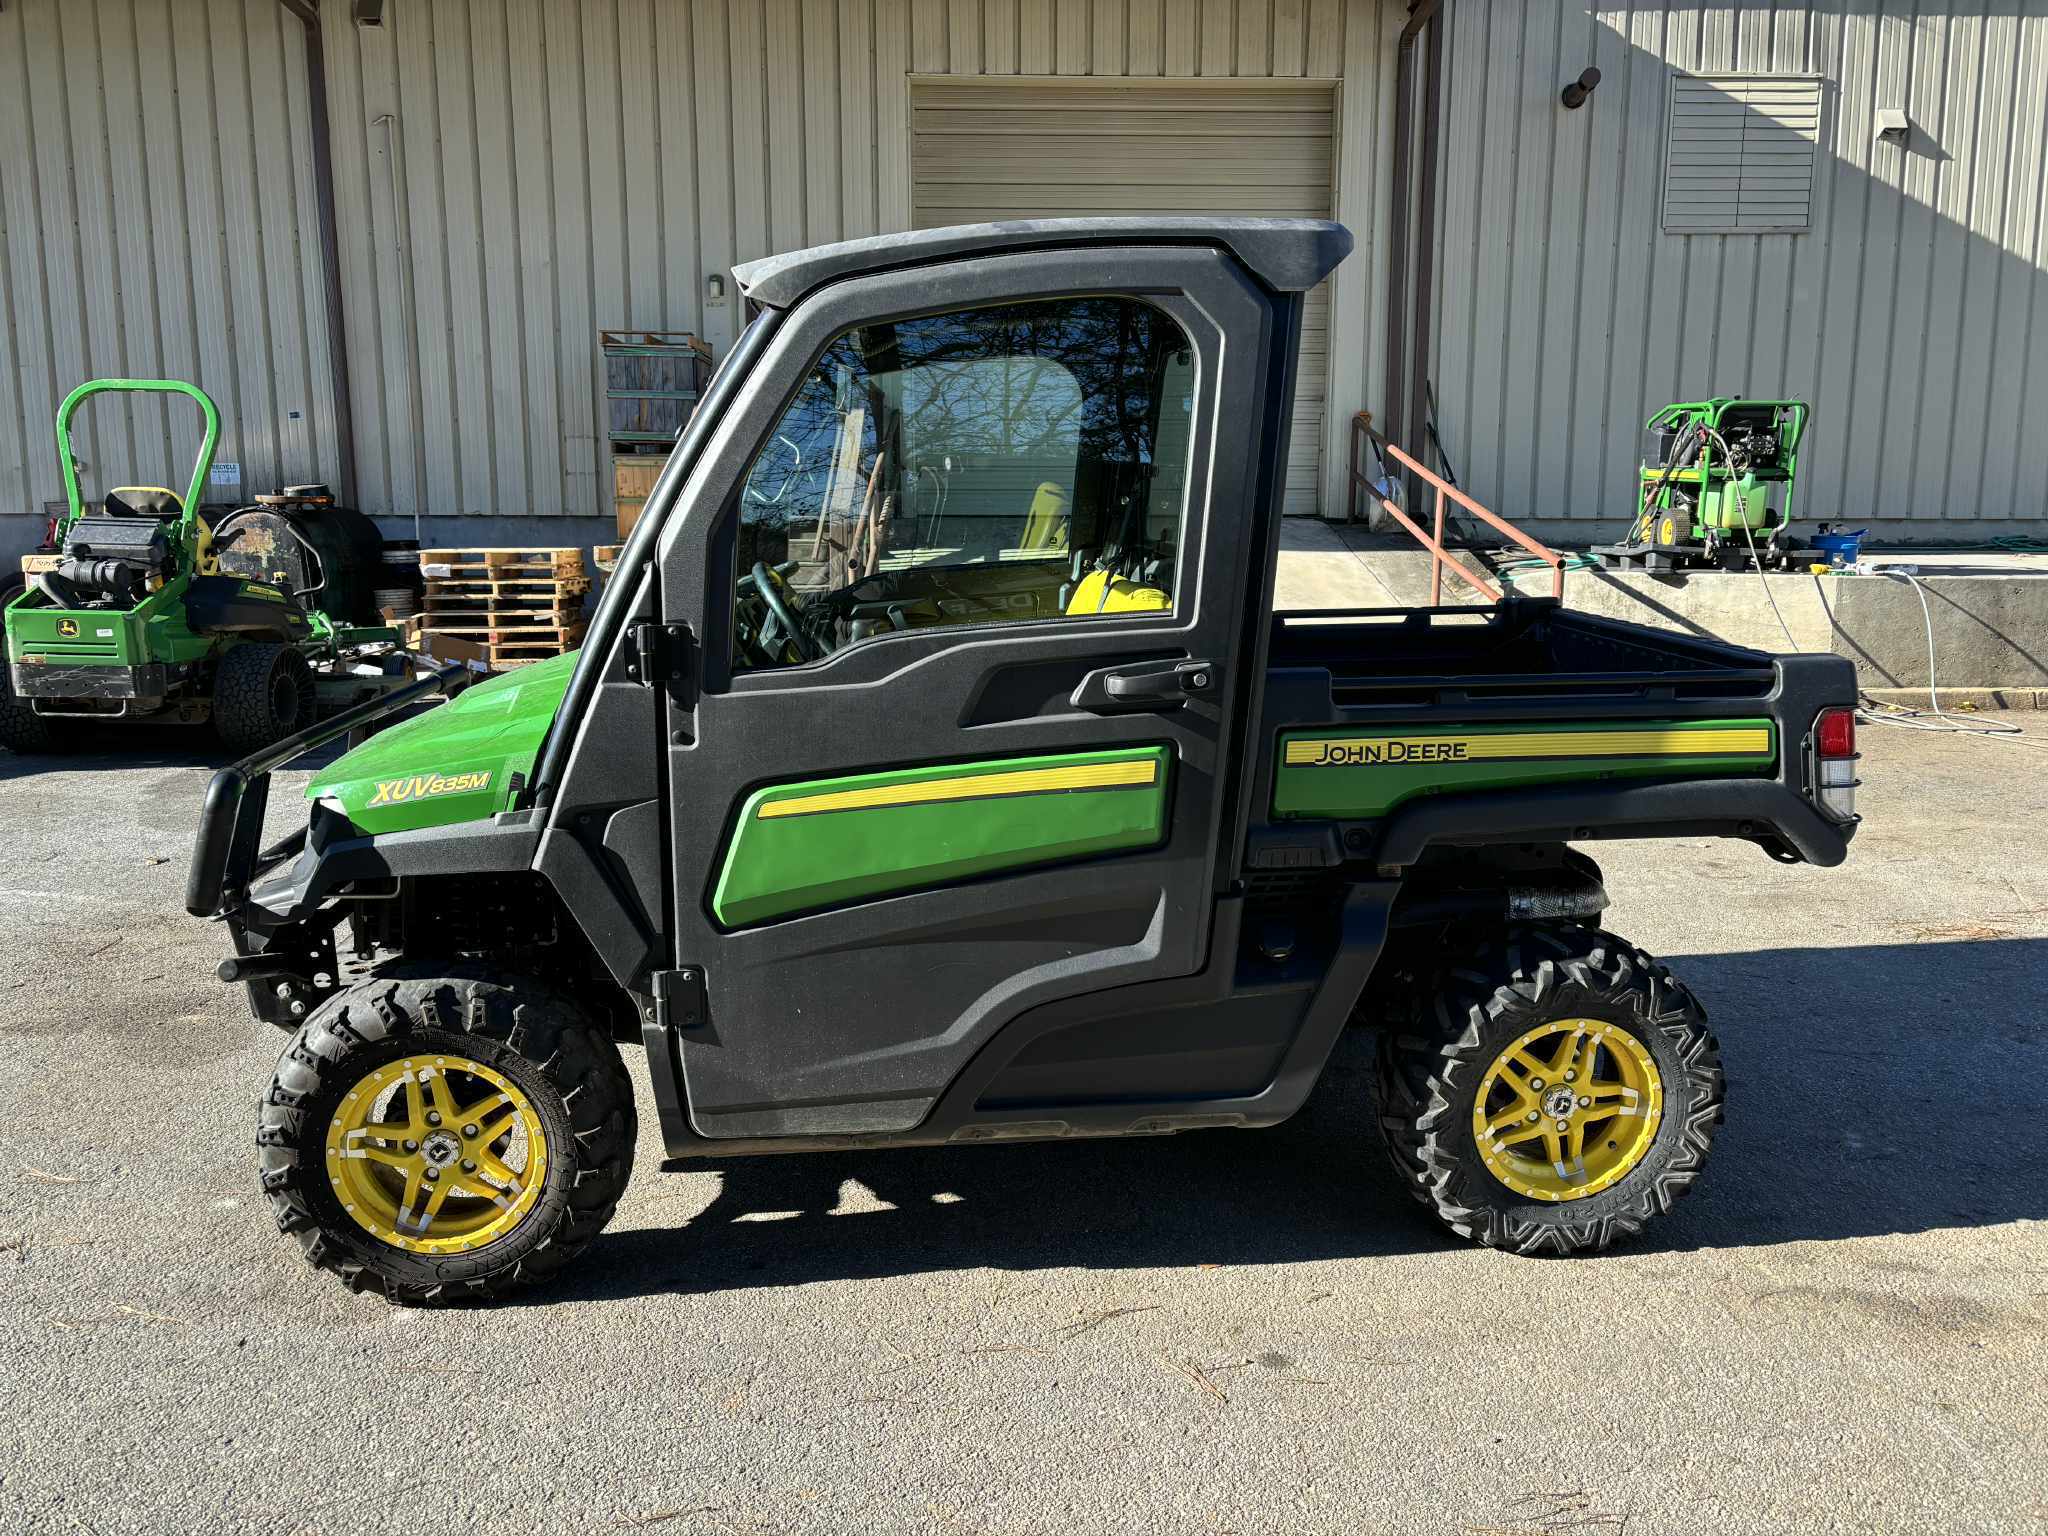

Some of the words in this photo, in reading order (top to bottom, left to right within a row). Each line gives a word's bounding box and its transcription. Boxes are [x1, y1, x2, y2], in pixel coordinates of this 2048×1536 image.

[1315, 743, 1381, 763] JOHN
[1387, 741, 1467, 760] DEERE
[370, 771, 490, 804] XUV835M
